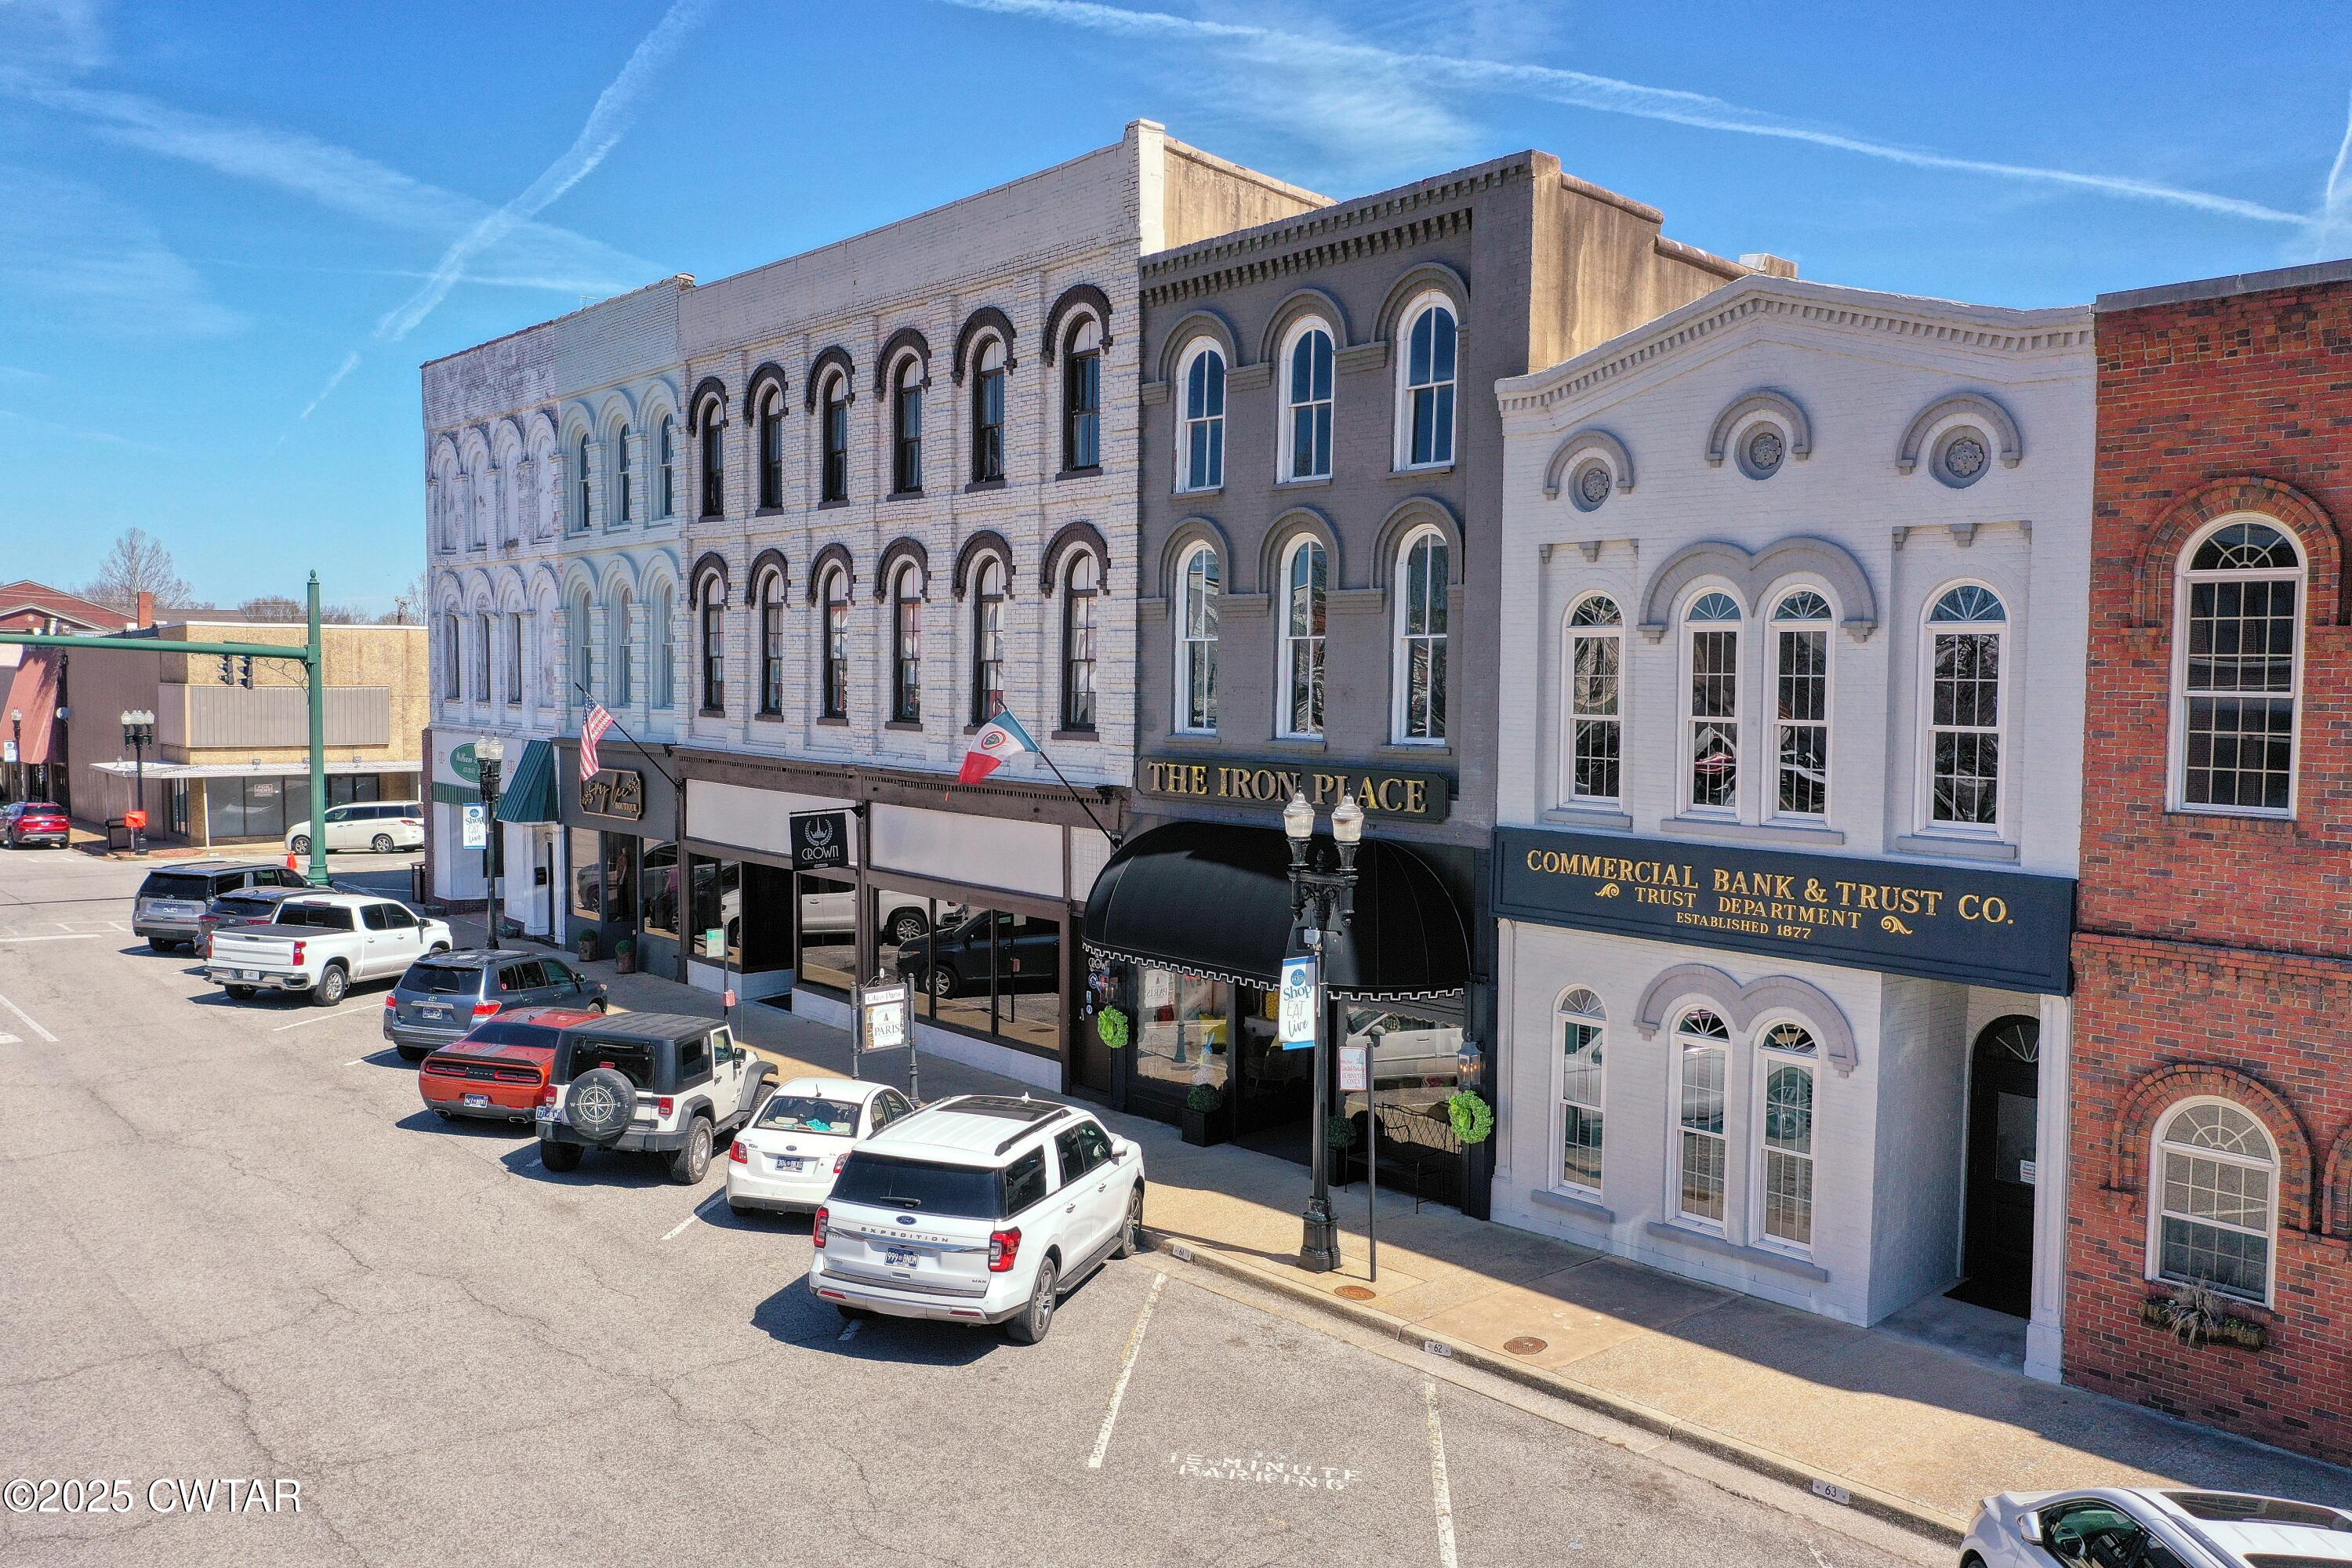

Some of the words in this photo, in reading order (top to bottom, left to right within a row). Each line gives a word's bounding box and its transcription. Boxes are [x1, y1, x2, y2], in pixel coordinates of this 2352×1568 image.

[1148, 761, 1208, 795] THE
[1217, 768, 1301, 802] IRON
[1312, 773, 1428, 814] PLACE
[615, 802, 637, 813] BOUTIQUE
[465, 816, 484, 826] Shop
[801, 844, 839, 860] CROWN
[1526, 849, 1699, 889] COMMERCIAL
[1713, 868, 1795, 901] BANK
[1805, 877, 1828, 904] &
[1835, 880, 1943, 916] TRUST
[1958, 894, 2015, 925] CO.
[1635, 887, 1697, 909] TRUST
[1718, 896, 1862, 929] DEPARTMENT
[1676, 912, 1769, 935] ESTABLISHED
[1777, 924, 1812, 940] 1877
[1283, 985, 1312, 1001] Shop
[1287, 1000, 1305, 1019] EAT
[874, 1023, 900, 1036] PARIS
[860, 1226, 949, 1243] EXPEDITION
[1434, 1343, 1443, 1353] 62
[1824, 1485, 1837, 1497] 63
